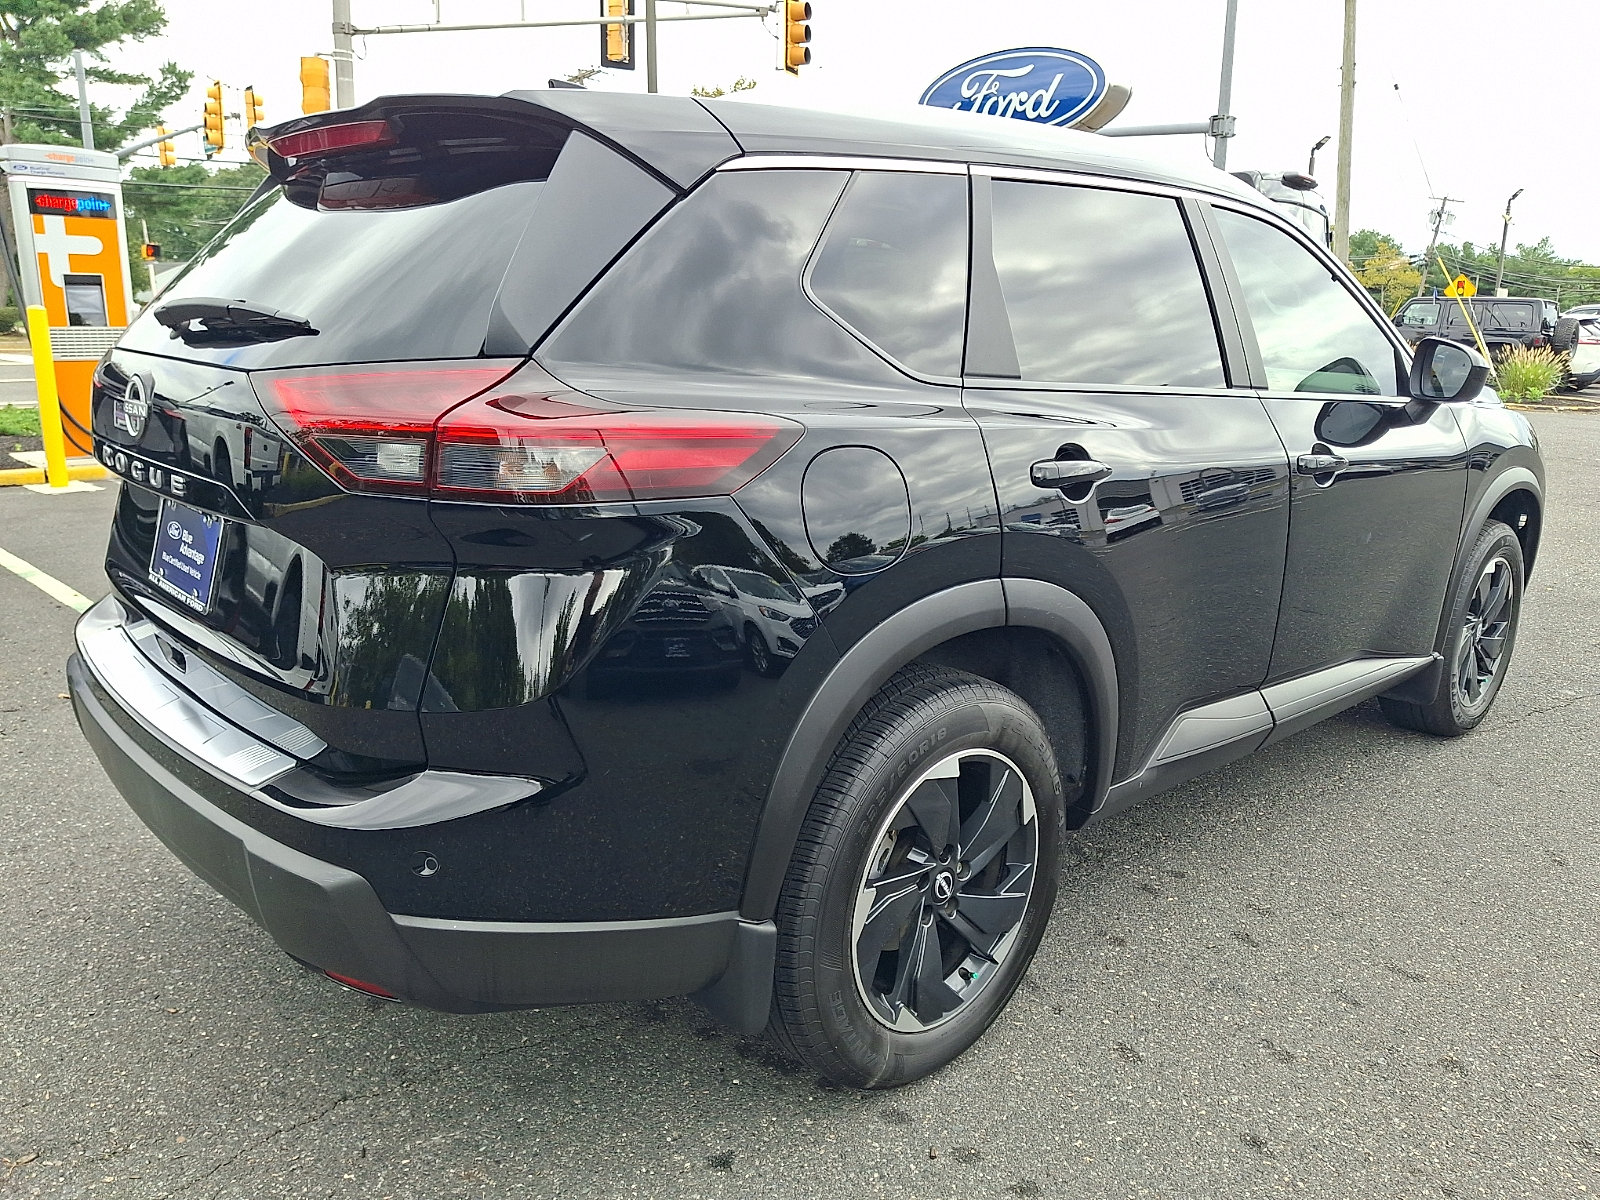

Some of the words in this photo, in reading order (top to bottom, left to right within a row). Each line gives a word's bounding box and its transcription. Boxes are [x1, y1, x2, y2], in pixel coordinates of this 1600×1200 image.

[953, 63, 1065, 119] Ford
[102, 441, 188, 498] ROGUE
[179, 541, 206, 566] Advantage
[181, 528, 194, 545] Blue
[148, 572, 160, 585] ALL
[159, 577, 187, 604] AMERICAN
[186, 595, 204, 612] FORD
